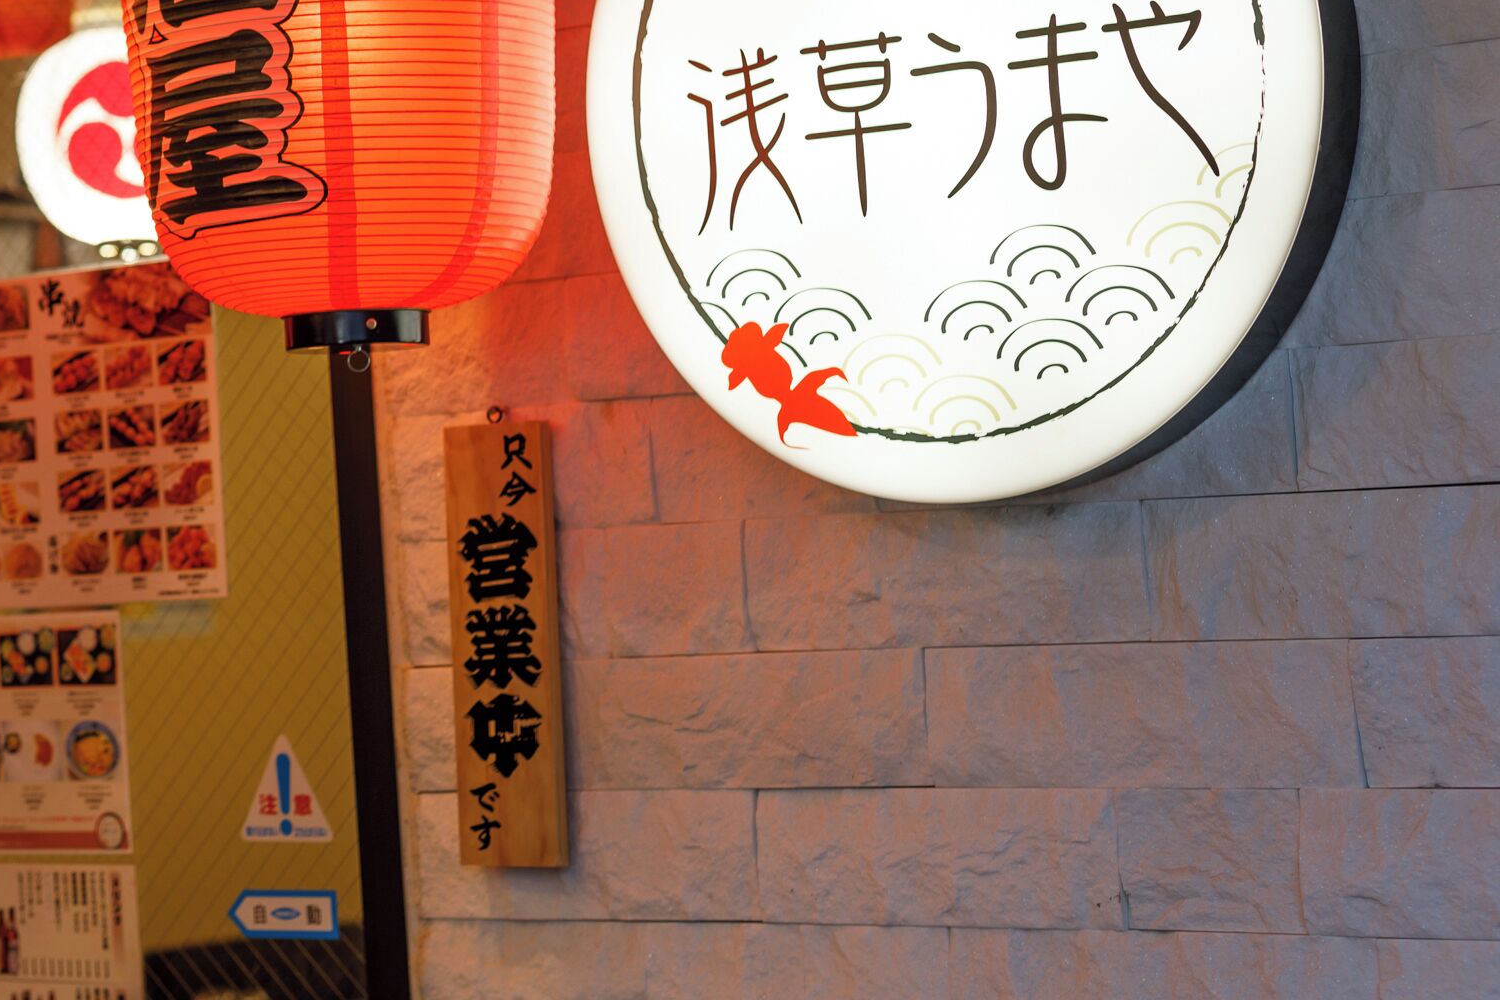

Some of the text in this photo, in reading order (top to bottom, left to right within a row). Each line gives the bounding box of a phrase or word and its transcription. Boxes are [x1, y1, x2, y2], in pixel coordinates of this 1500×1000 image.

[687, 0, 1220, 237] 浅草うまや
